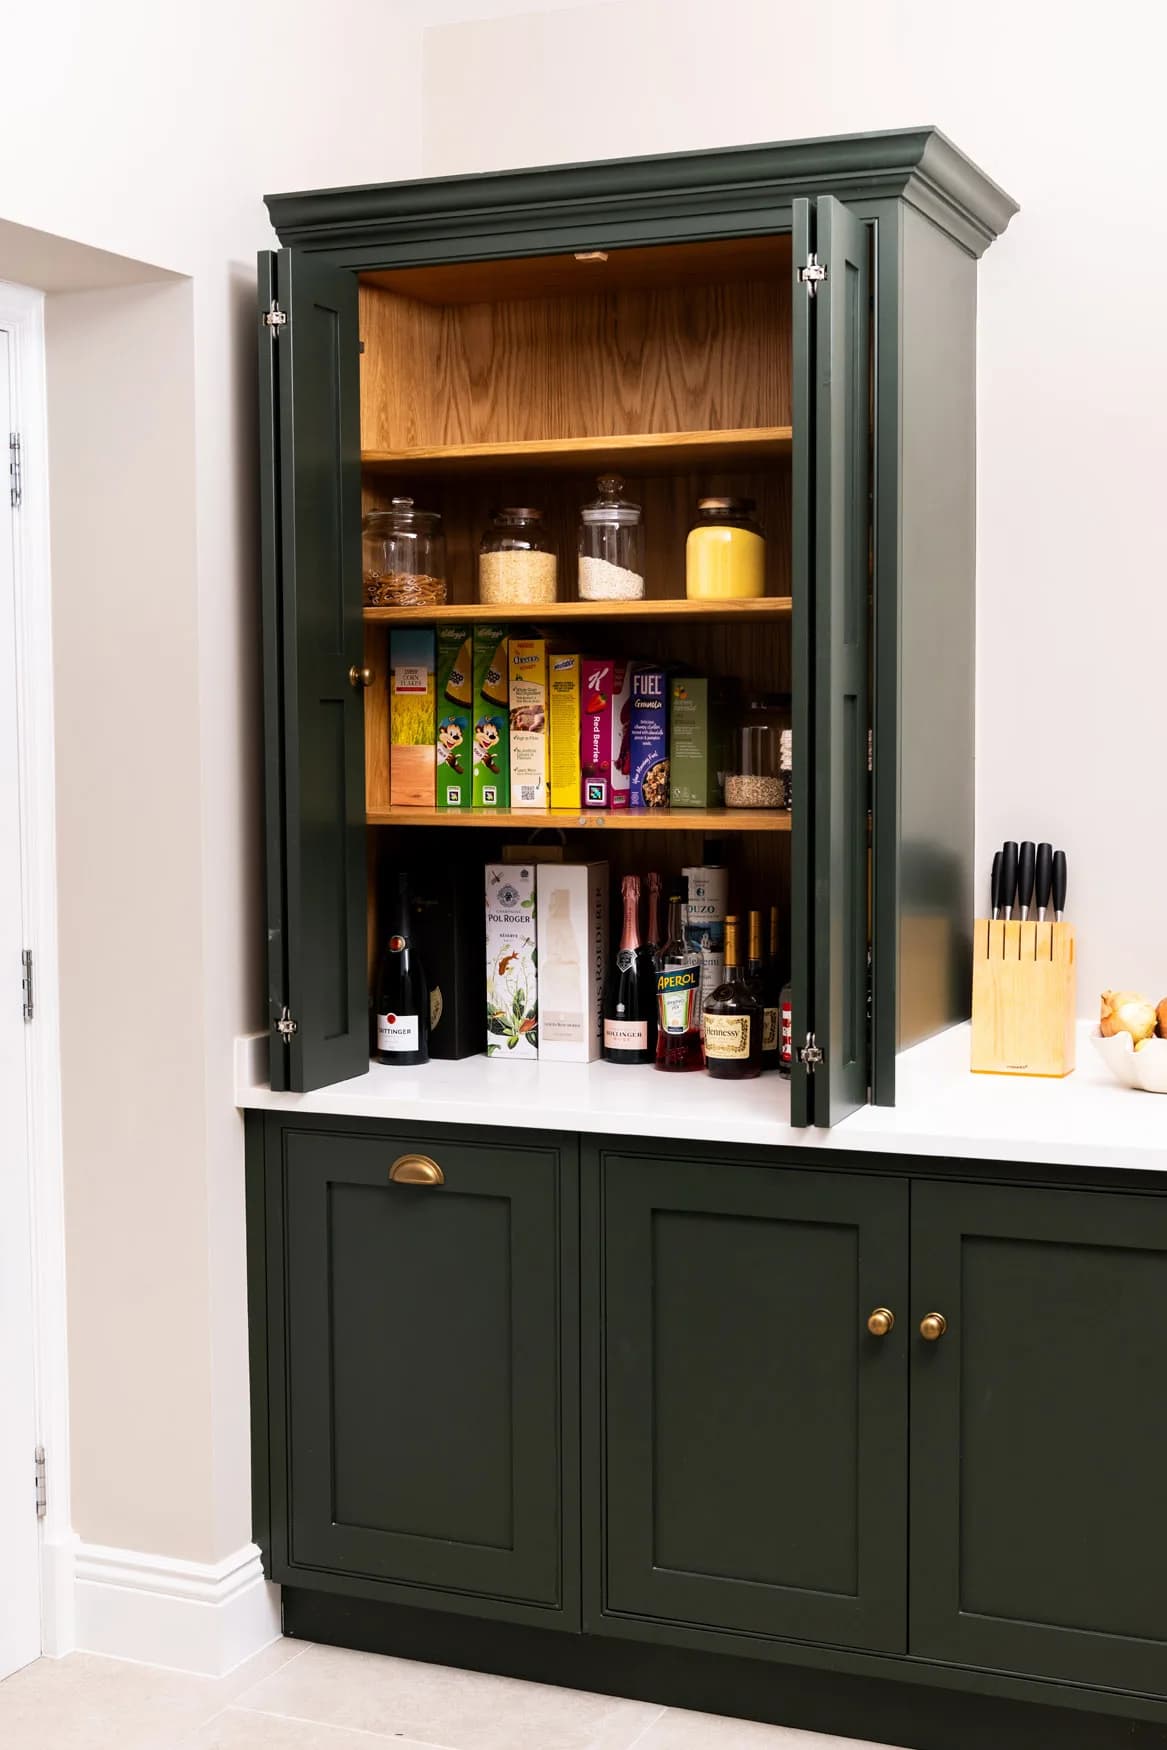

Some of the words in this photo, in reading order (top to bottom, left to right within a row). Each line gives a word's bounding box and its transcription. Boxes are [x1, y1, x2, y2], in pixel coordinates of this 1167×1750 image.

[588, 667, 609, 691] K
[633, 675, 662, 695] FUEL
[593, 716, 601, 732] Red
[592, 734, 601, 763] Berries
[488, 914, 504, 922] POL
[504, 914, 530, 923] ROGER
[657, 972, 696, 991] APEROL
[705, 1027, 739, 1039] Hennessy
